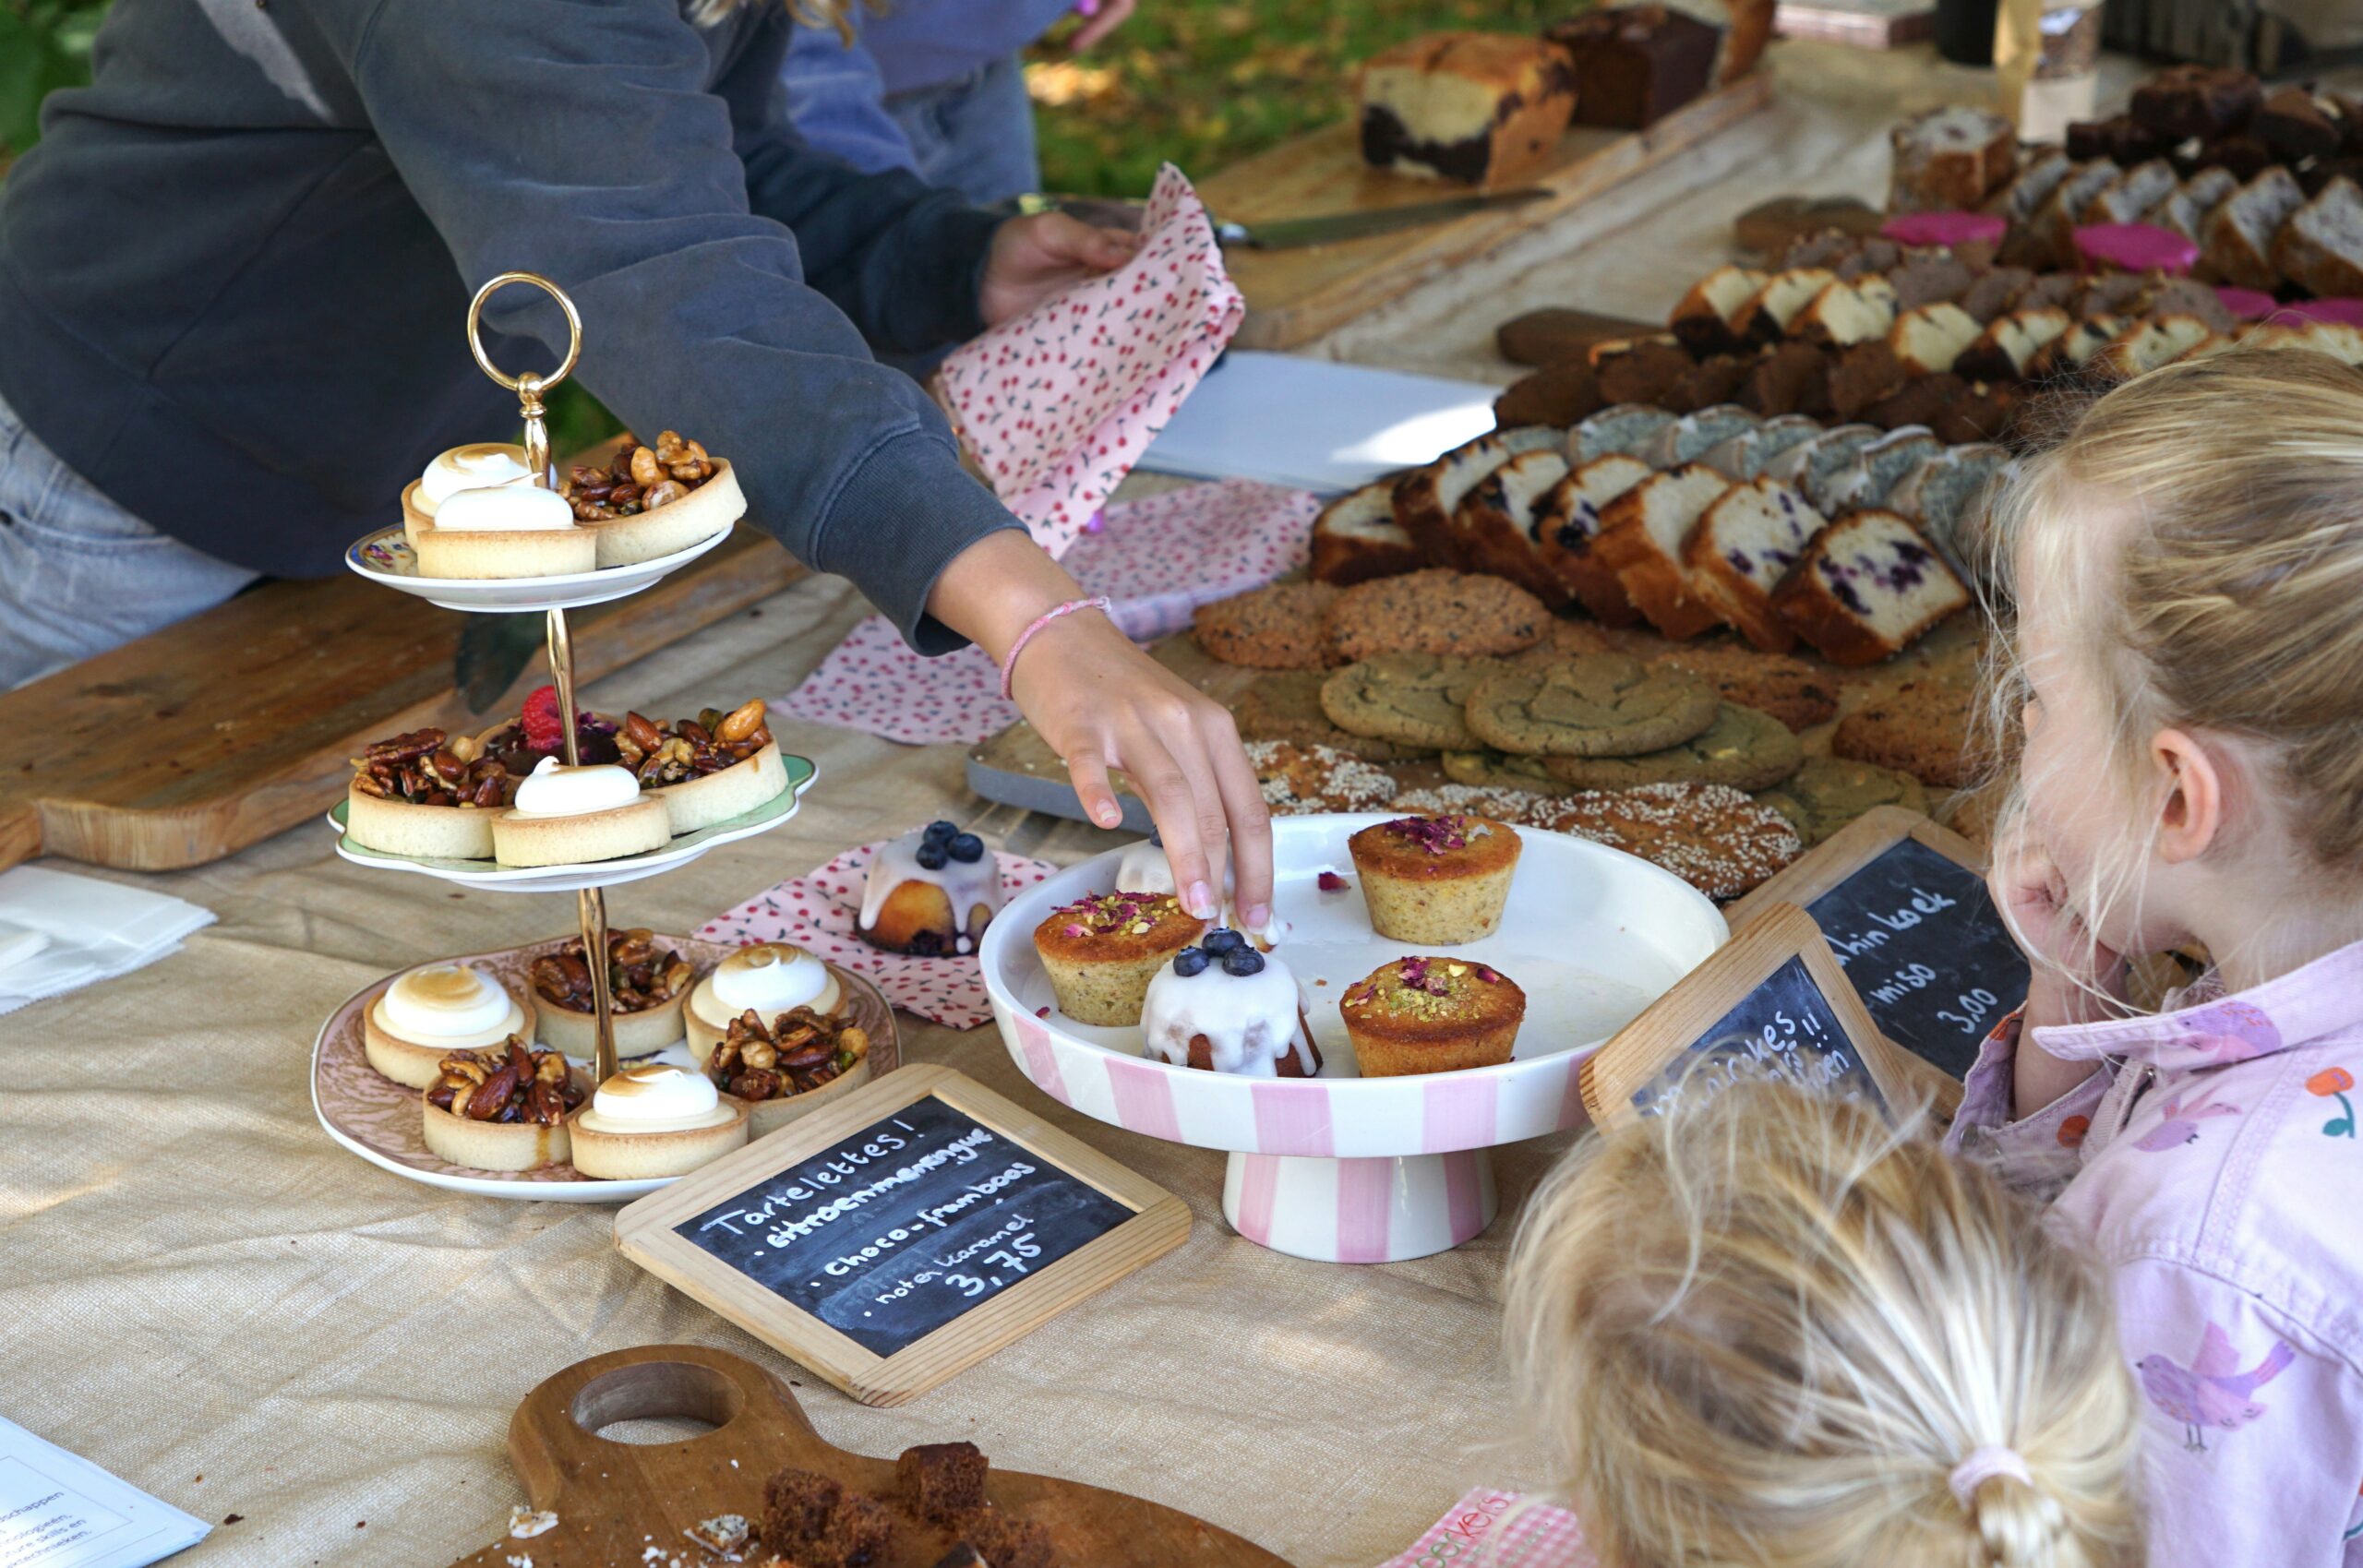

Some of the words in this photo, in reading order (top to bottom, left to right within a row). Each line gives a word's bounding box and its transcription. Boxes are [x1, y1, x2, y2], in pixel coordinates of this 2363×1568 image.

[1869, 963, 1937, 996] miso
[1937, 987, 1998, 1035] 3,00
[944, 1232, 1042, 1297] 3,75
[69, 1519, 87, 1529] en
